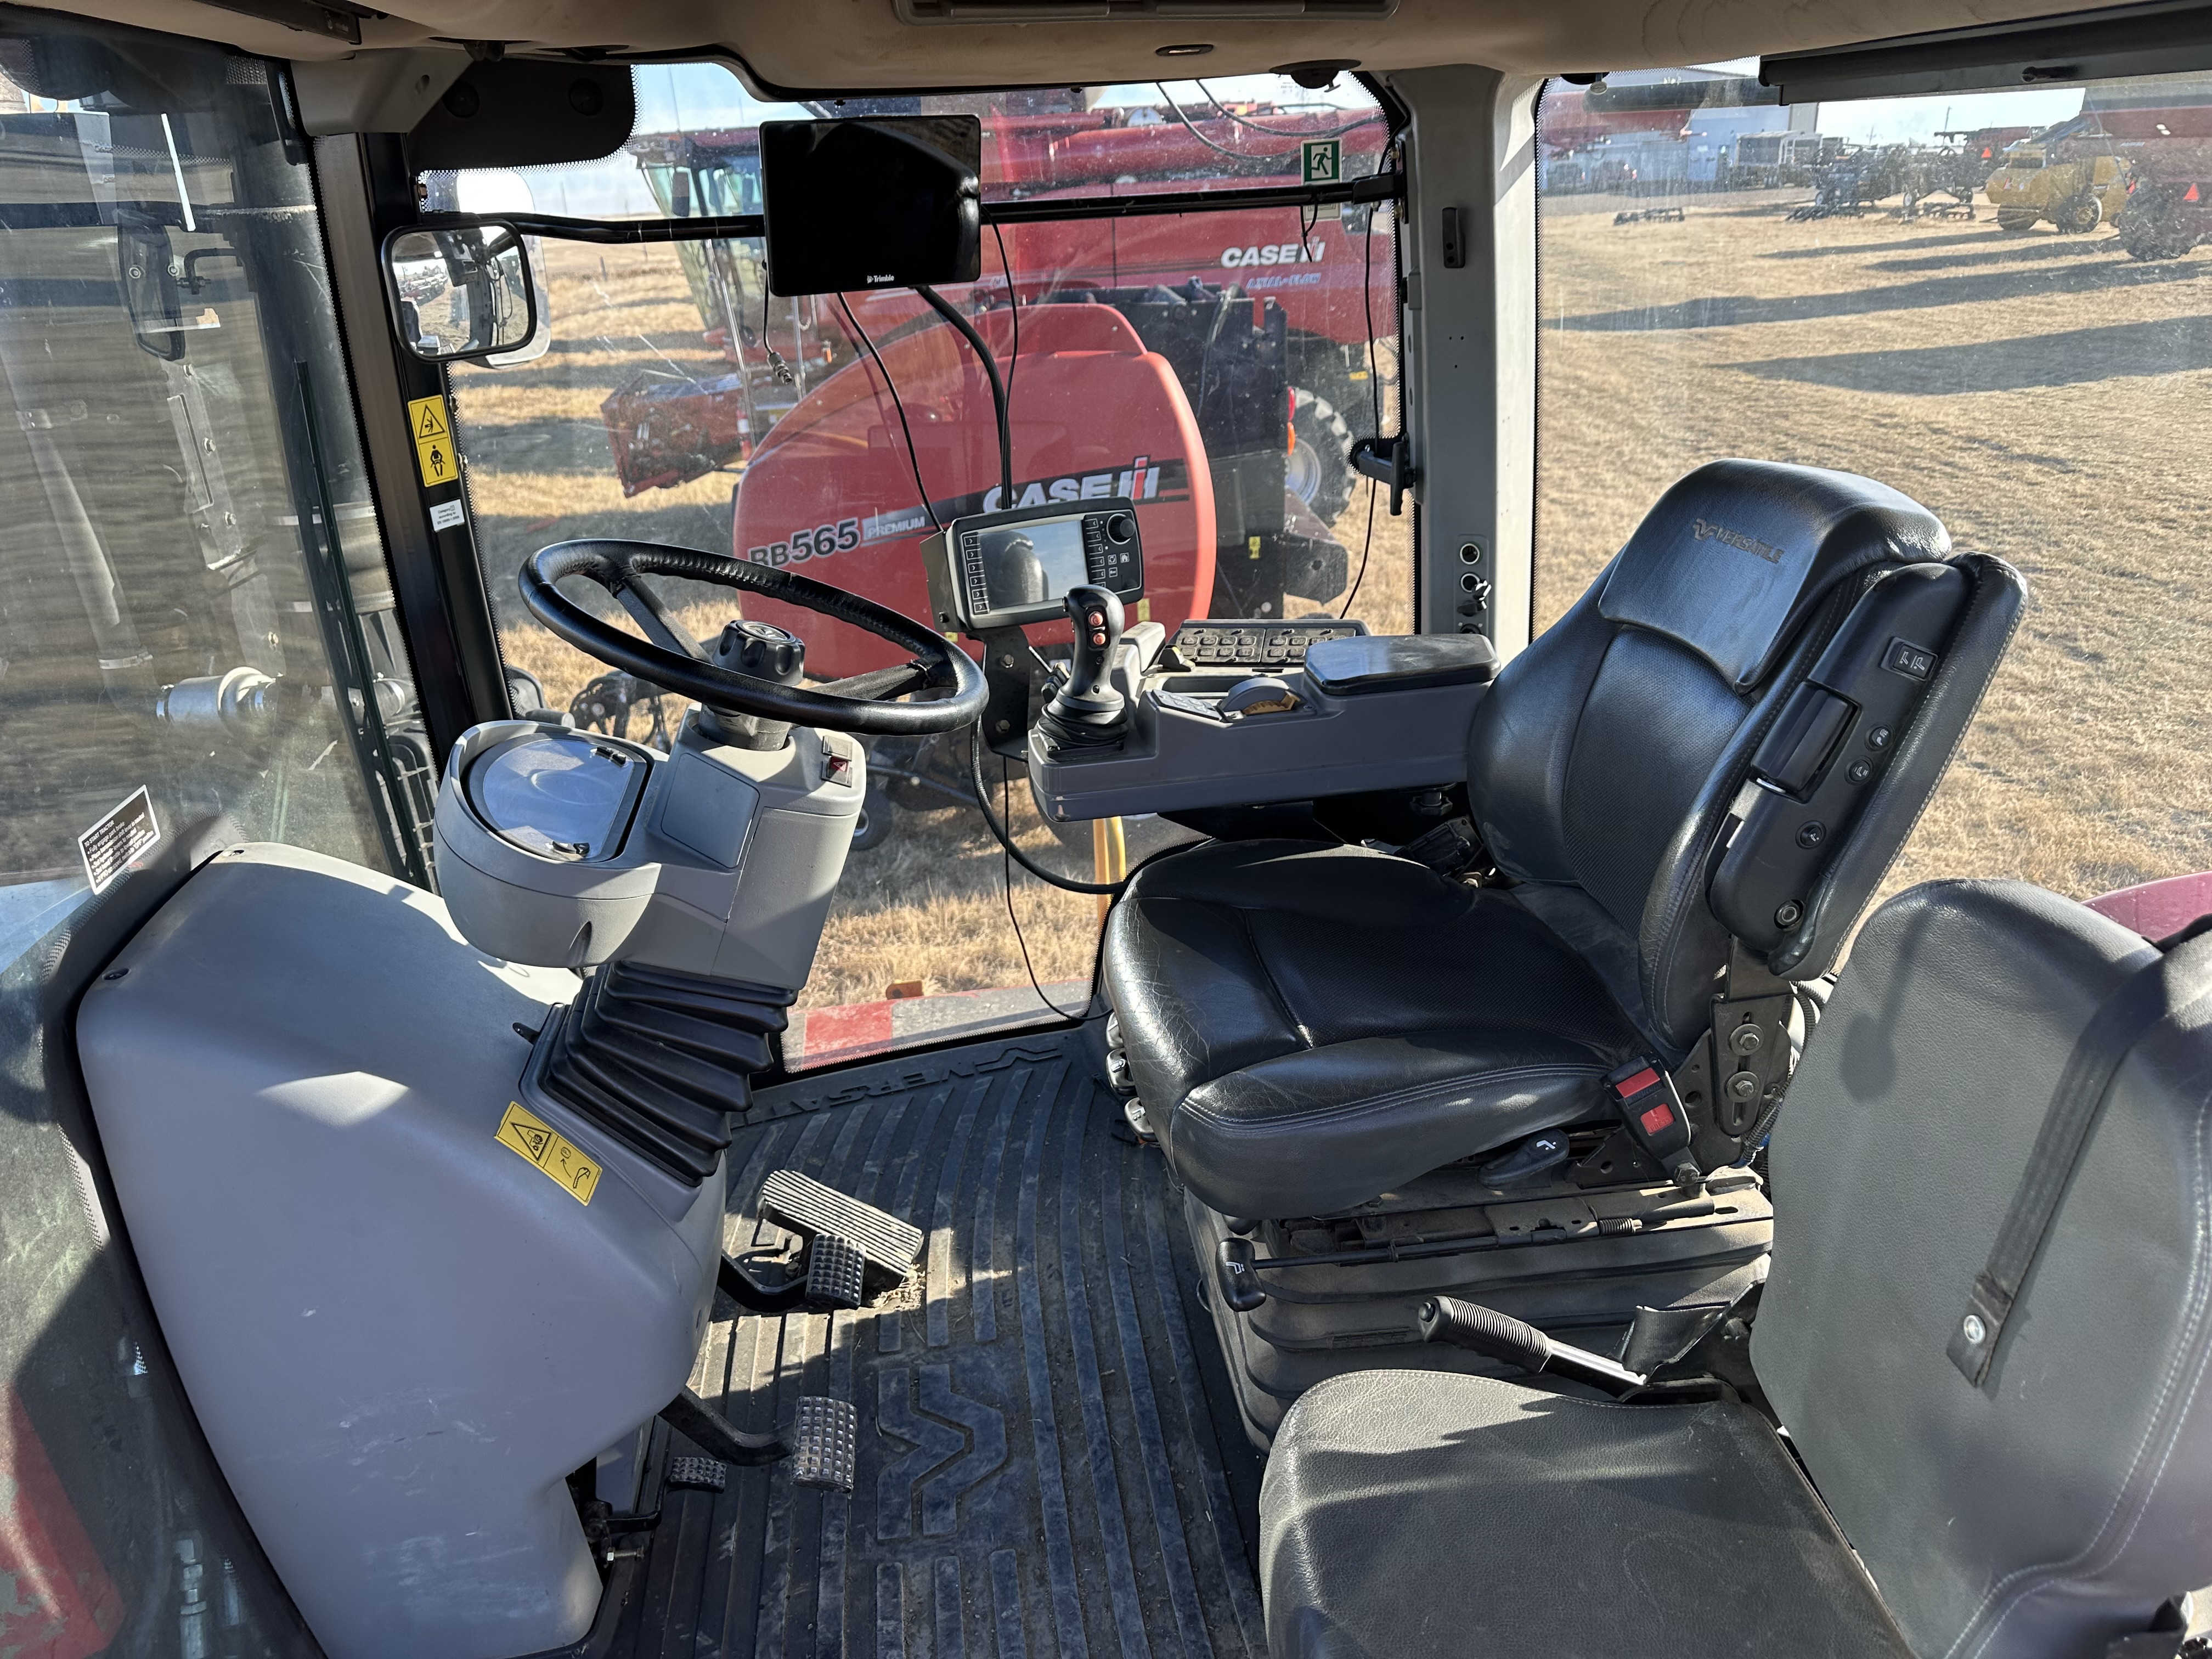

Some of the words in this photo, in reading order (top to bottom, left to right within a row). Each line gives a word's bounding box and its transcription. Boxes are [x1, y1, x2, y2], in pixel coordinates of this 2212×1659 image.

[1221, 244, 1299, 268] CASE
[873, 274, 894, 283] Trimble
[868, 517, 926, 538] PREMIUM
[1716, 527, 1785, 565] VERSATILE
